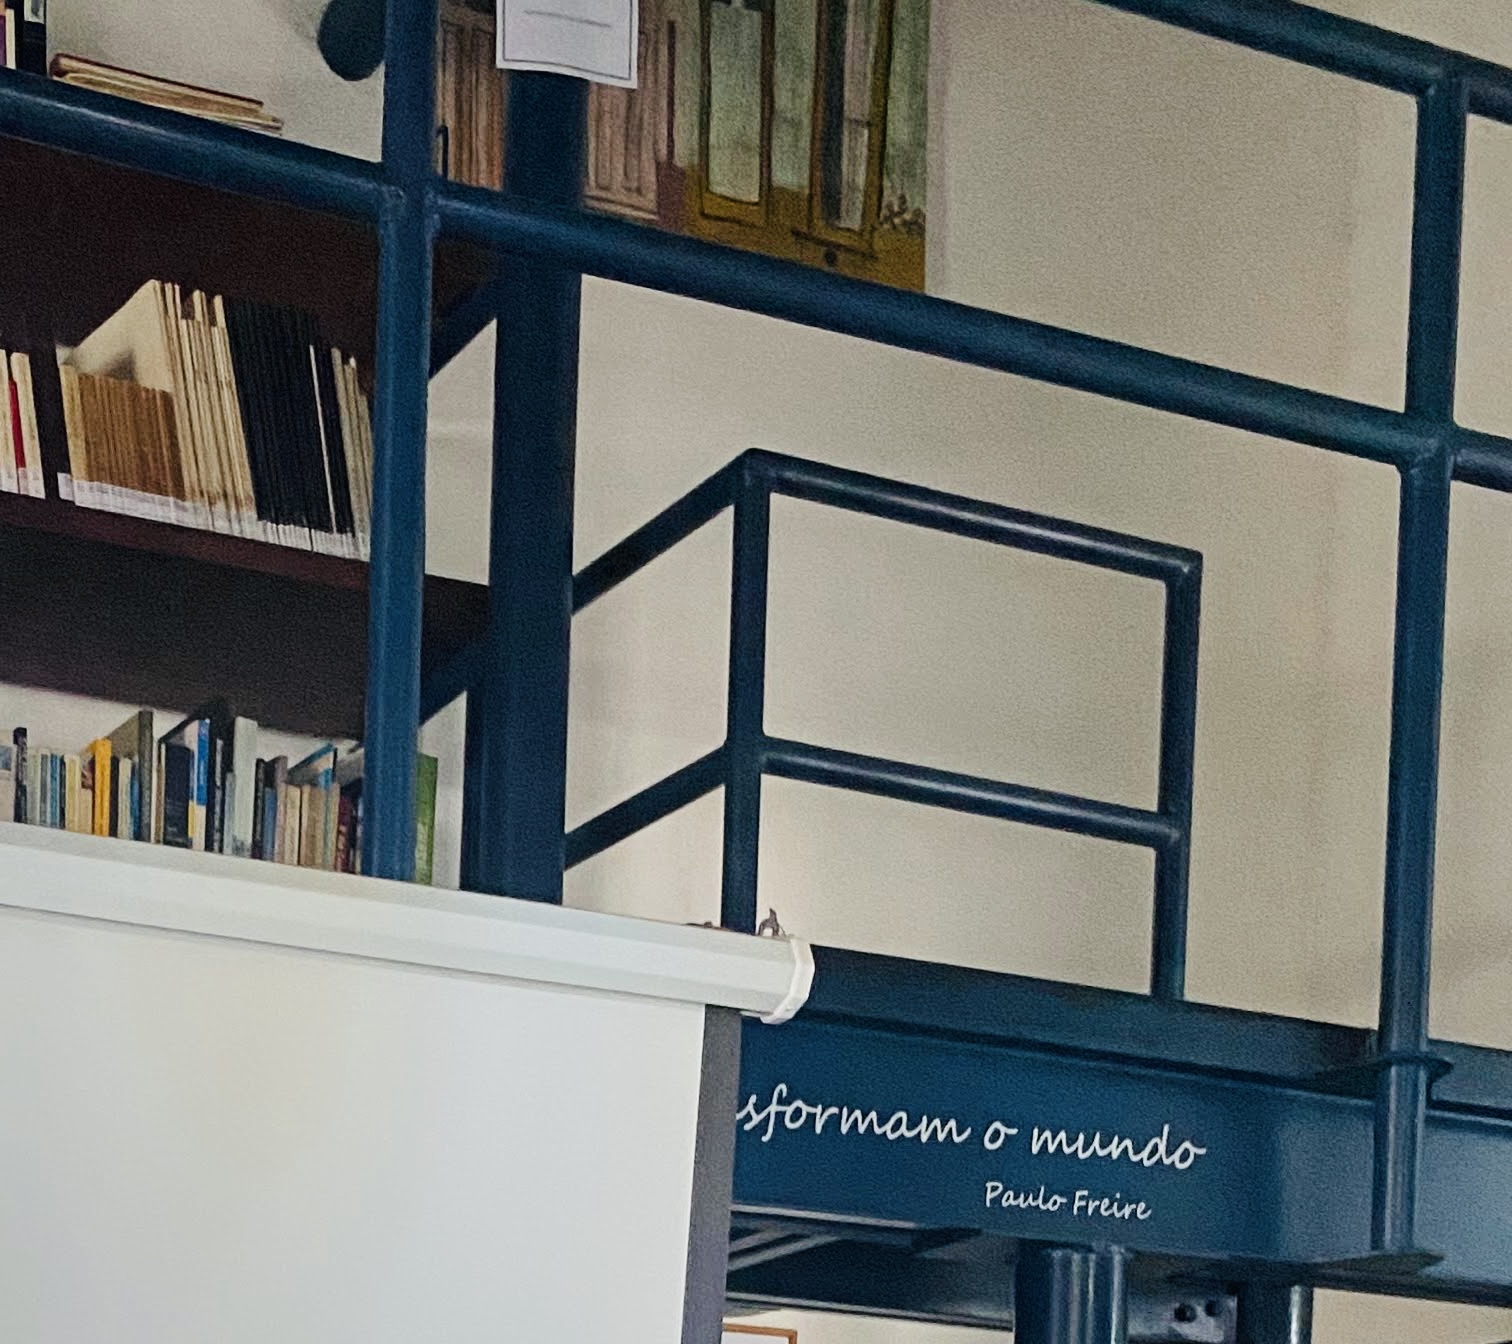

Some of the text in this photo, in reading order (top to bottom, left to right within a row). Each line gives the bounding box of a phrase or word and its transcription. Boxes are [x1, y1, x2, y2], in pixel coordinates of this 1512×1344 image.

[981, 1120, 1019, 1152] o
[1030, 1123, 1207, 1171] mundo
[983, 1181, 1153, 1221] Paulo Freire
